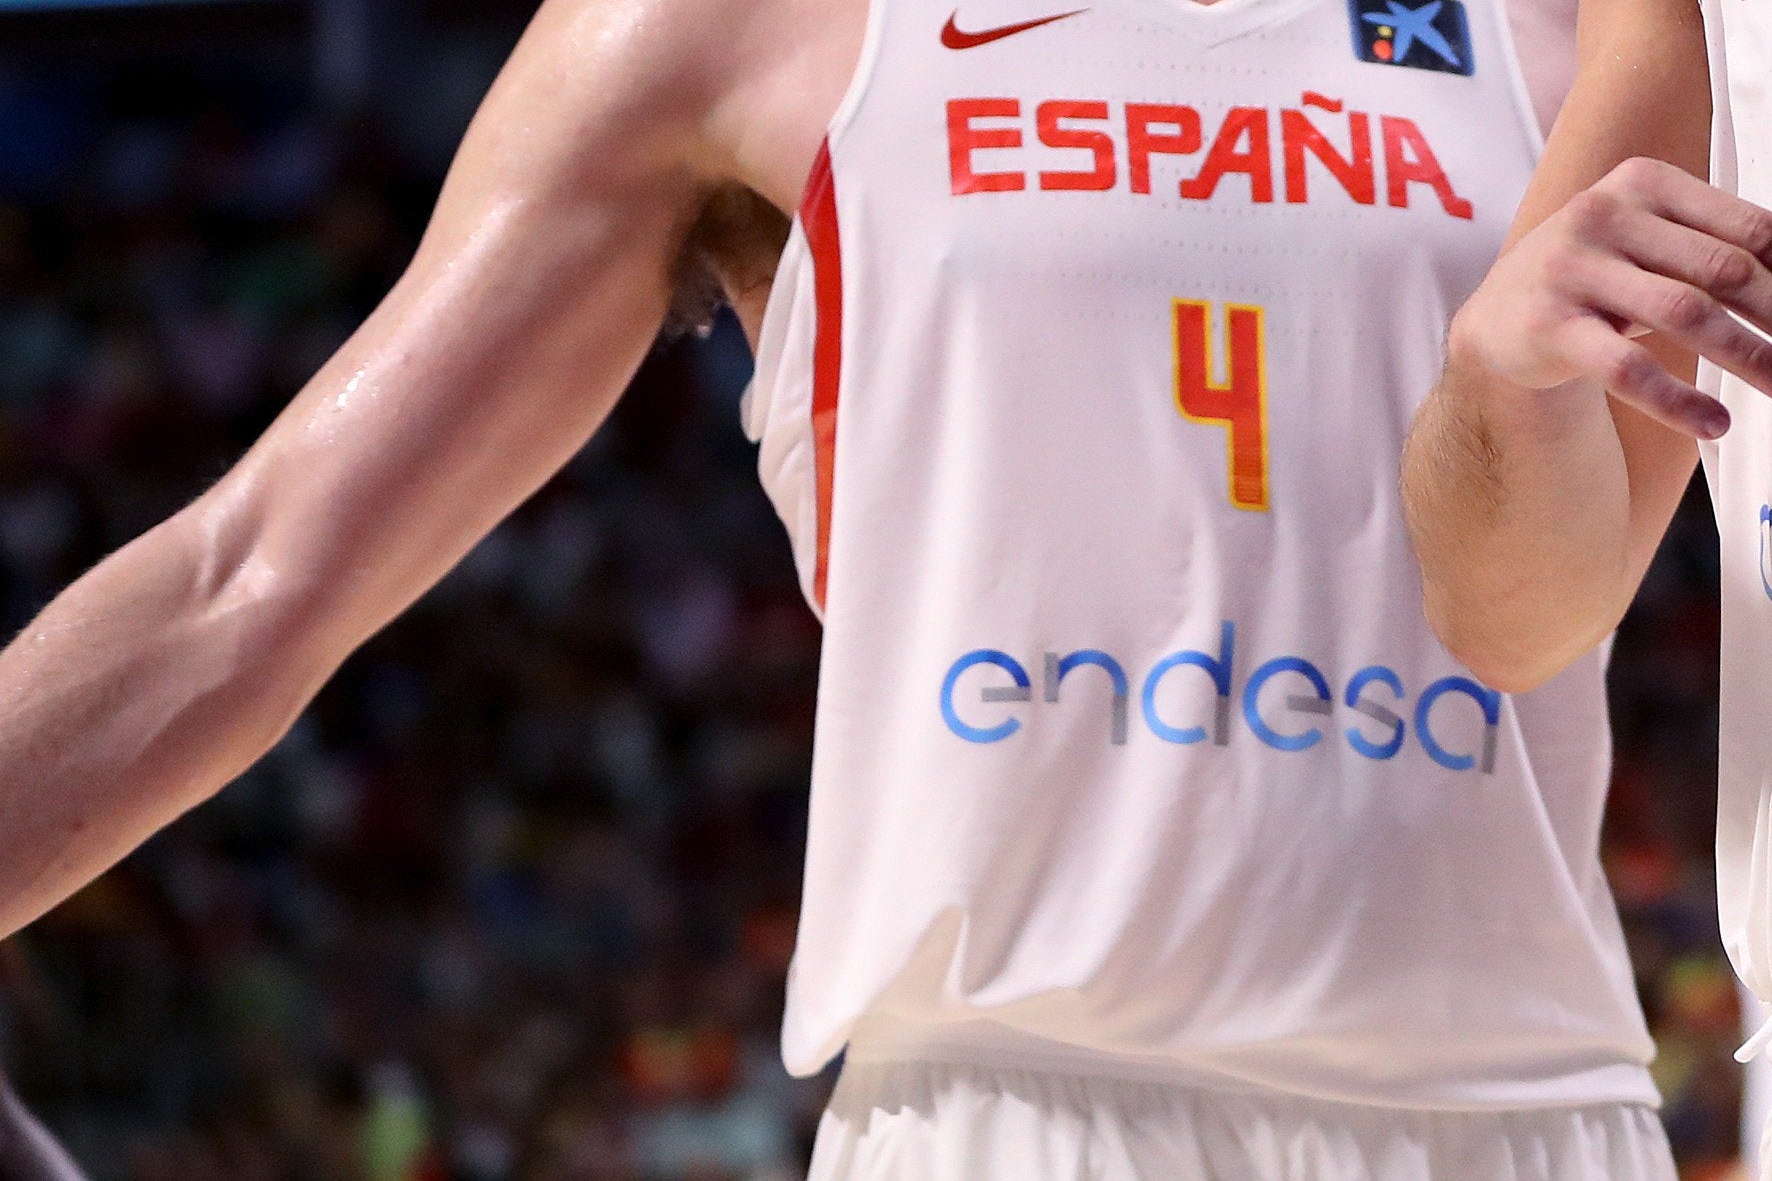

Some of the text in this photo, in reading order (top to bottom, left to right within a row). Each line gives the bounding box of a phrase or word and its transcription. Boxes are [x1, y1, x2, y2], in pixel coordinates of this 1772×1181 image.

[945, 91, 1474, 220] ESPAÑA
[1171, 296, 1270, 513] 4
[940, 619, 1501, 776] endesa
